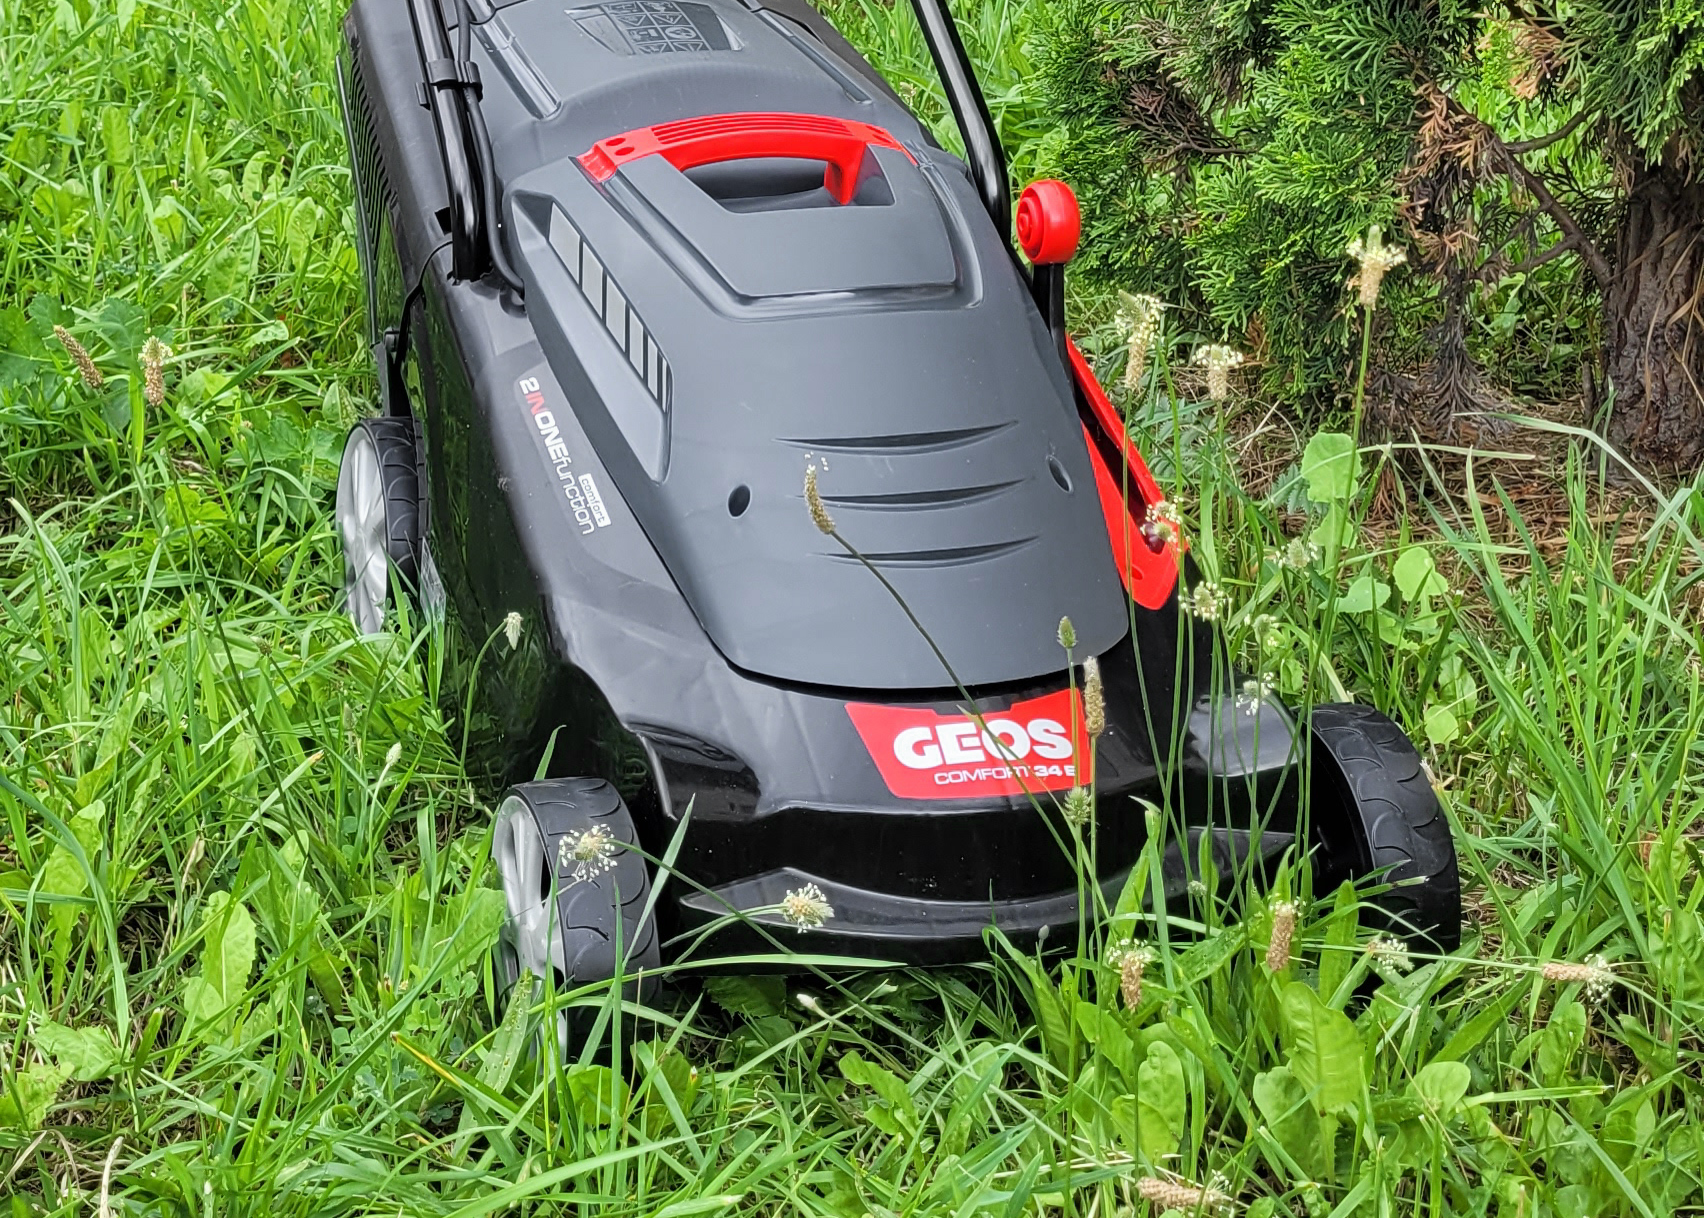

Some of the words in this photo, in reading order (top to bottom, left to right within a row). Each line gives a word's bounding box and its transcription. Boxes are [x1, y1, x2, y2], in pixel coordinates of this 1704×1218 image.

[580, 478, 607, 524] comfort
[893, 718, 1074, 769] GEOS
[934, 766, 1030, 785] COMFORT
[1033, 765, 1062, 777] 34
